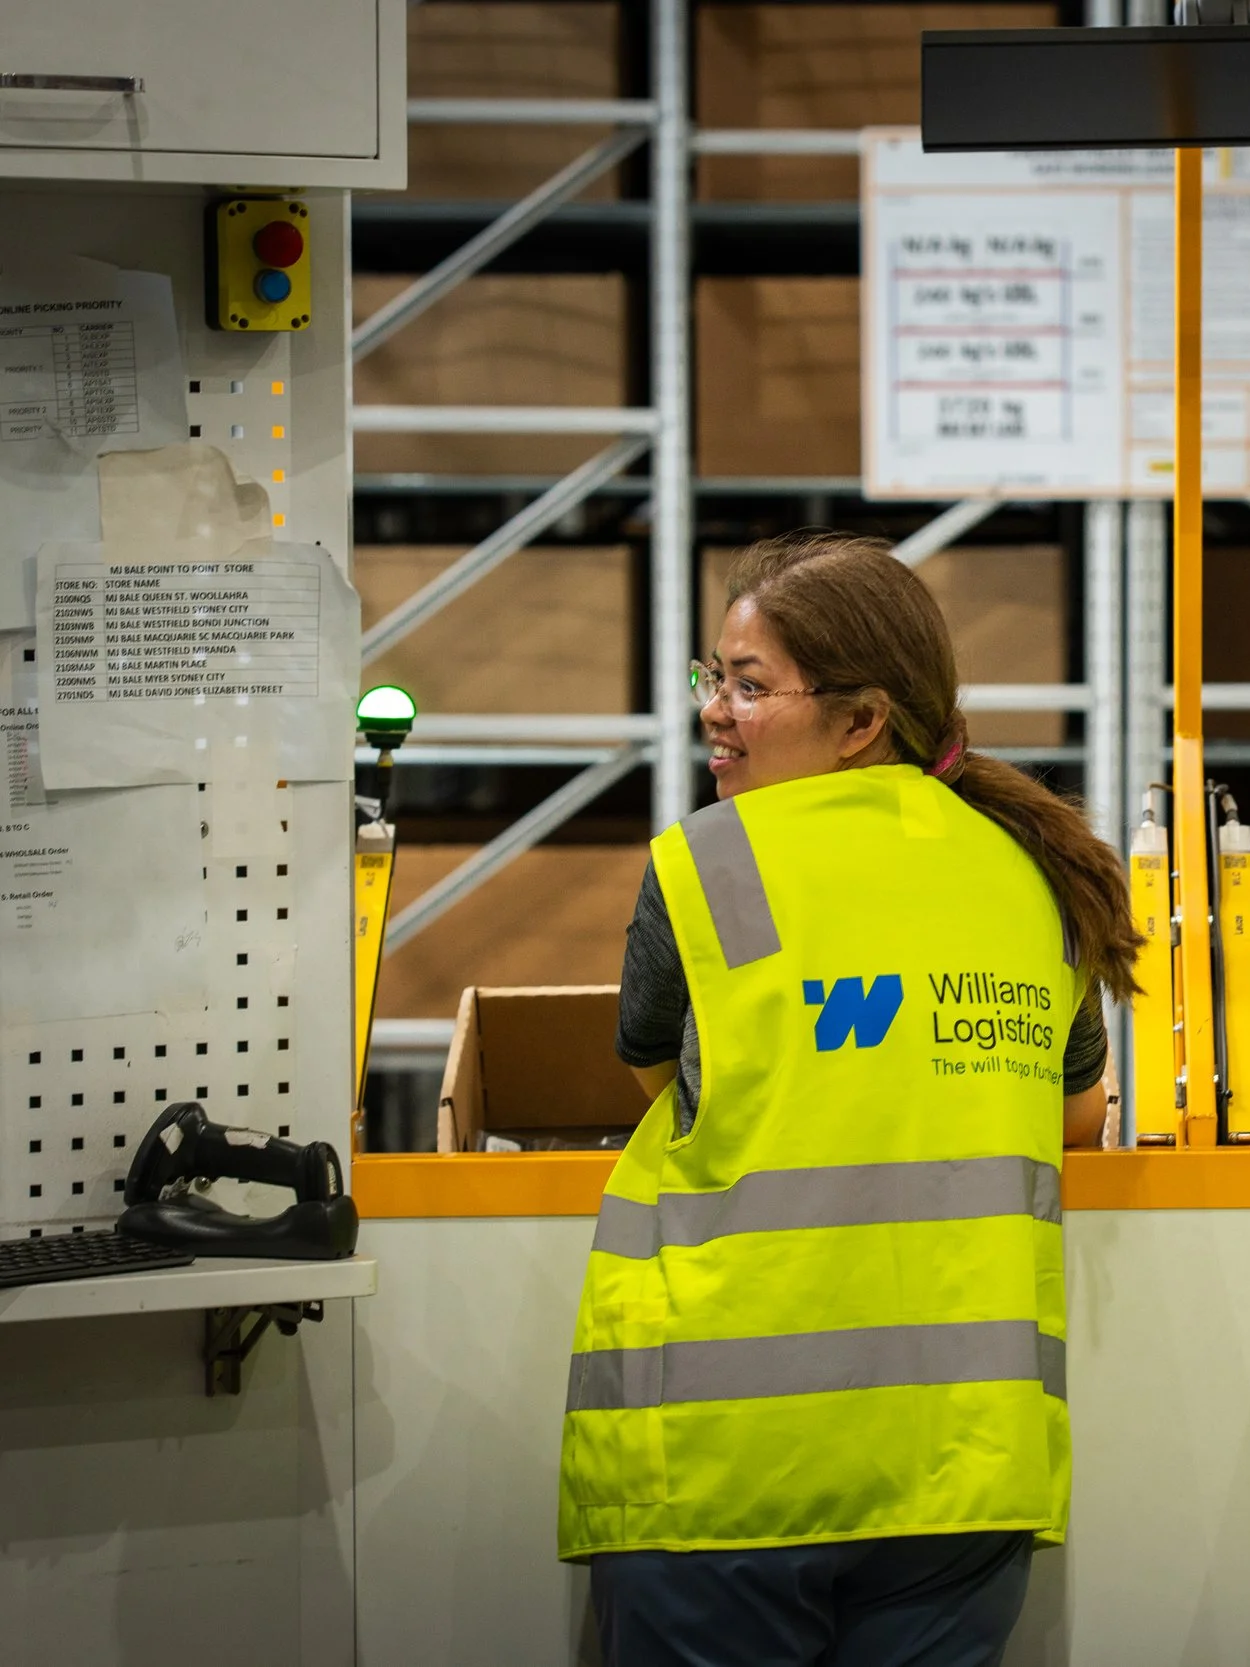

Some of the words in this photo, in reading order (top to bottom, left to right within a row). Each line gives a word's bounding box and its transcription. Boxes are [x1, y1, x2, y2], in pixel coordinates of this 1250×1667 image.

[33, 303, 73, 313] PICKING
[75, 300, 122, 309] PRIORITY
[110, 566, 122, 574] MJ
[125, 566, 145, 574] BALE
[147, 565, 174, 574] POINT
[177, 565, 189, 574] TO
[192, 564, 219, 573] POINT
[224, 564, 254, 573] STORE
[56, 581, 80, 590] STORE
[105, 579, 133, 588] STORE
[134, 579, 160, 588] NAME
[106, 594, 118, 602] MJ
[119, 593, 140, 602] BALE
[142, 592, 172, 601] QUEEN
[190, 591, 248, 600] WOOLLAHRA
[106, 607, 118, 616] MJ
[120, 607, 140, 615] BALE
[142, 606, 189, 615] WESTFIELD
[192, 605, 226, 614] SYDNEY
[229, 605, 249, 613] CITY
[106, 621, 118, 629] MJ
[120, 620, 140, 629] BALE
[143, 619, 189, 628] WESTFIELD
[192, 619, 221, 627] BONDI
[224, 618, 270, 627] JUNCTION
[107, 635, 119, 643] MJ
[121, 634, 141, 643] BALE
[144, 633, 197, 642] MACQUARIE
[199, 632, 209, 640] SC
[211, 632, 268, 641] MACQUARIE
[270, 631, 294, 640] PARK
[107, 649, 119, 657] MJ
[121, 648, 141, 656] BALE
[144, 647, 190, 655] WESTFIELD
[192, 646, 236, 654] MIRANDA
[108, 662, 120, 671] MJ
[121, 661, 142, 670] BALE
[144, 661, 178, 669] MARTIN
[181, 659, 207, 668] PLACE
[109, 675, 120, 684] MJ
[123, 675, 142, 684] BALE
[145, 675, 169, 683] MYER
[170, 674, 203, 682] SYDNEY
[206, 673, 225, 681] CITY
[109, 690, 121, 698] MJ
[123, 689, 143, 697] BALE
[146, 688, 172, 697] DAVID
[174, 687, 201, 696] JONES
[203, 686, 248, 695] ELIZABETH
[251, 685, 283, 694] STREET
[47, 847, 69, 855] Order
[9, 892, 31, 900] Retail
[32, 890, 53, 898] Order
[928, 972, 1051, 1011] Williams
[933, 1010, 1053, 1050] Logistics
[932, 1058, 966, 1077] The
[970, 1056, 1001, 1073] will
